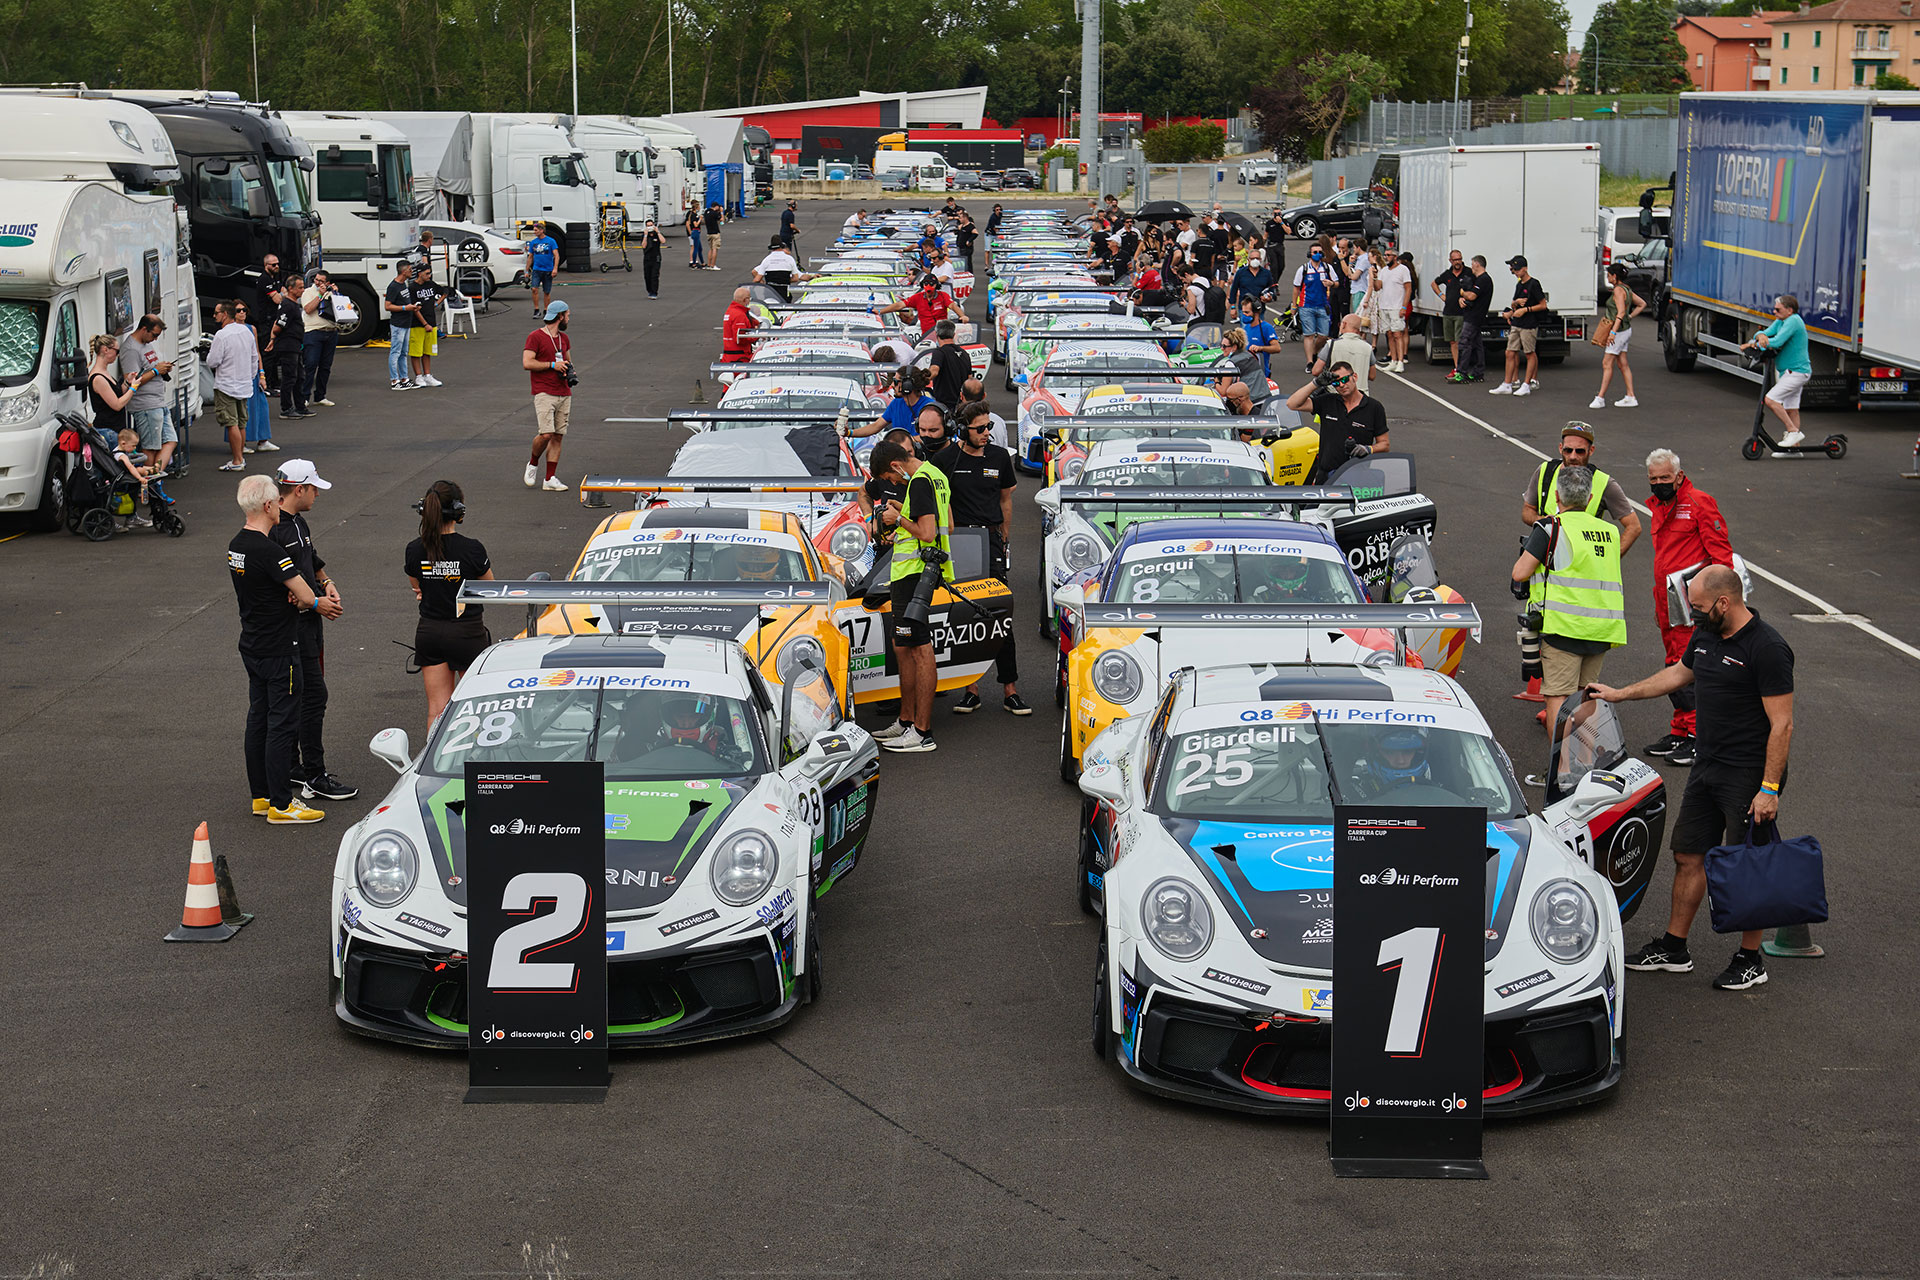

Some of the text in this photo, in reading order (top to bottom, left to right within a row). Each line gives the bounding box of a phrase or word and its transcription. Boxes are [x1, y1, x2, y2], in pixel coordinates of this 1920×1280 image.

[1807, 115, 1825, 147] HD
[1715, 152, 1770, 200] L'OPERA
[797, 388, 838, 396] Perform
[723, 396, 781, 409] Quaresmini
[1157, 396, 1200, 404] Perform
[1084, 403, 1133, 417] Moretti
[1119, 455, 1230, 465] Q8 Hi Perform
[1092, 463, 1157, 481] Iaquinta
[1149, 491, 1266, 499] discoverglo.it
[1357, 496, 1417, 513] Centro Porsche
[632, 532, 768, 545] Q8 Hi Perform
[1581, 530, 1613, 544] MEDIA
[583, 543, 664, 566] Fulgenzi
[1161, 543, 1302, 555] Q8 Hi Perform
[1594, 544, 1605, 558] 99
[432, 568, 461, 576] FULGENZI
[575, 559, 622, 582] 17
[1129, 557, 1195, 578] Cerqui
[477, 584, 816, 599] glo discoverglo.it glo
[955, 583, 986, 594] Centro
[1131, 577, 1160, 603] 8
[700, 605, 733, 613] Pesaro
[1103, 606, 1463, 622] glo discoverglo.it glo
[632, 623, 733, 633] SPAZIO ASTE
[842, 616, 872, 648] 17
[506, 674, 691, 689] Q8 Hi Perform
[859, 671, 883, 682] Perform
[456, 693, 537, 719] Amati
[1239, 708, 1437, 724] Q8 Hi Perform
[441, 710, 518, 755] 28
[1182, 727, 1297, 754] Giardelli
[1174, 746, 1255, 797] 25
[617, 788, 680, 798] Firenze
[798, 786, 821, 826] 28
[489, 823, 581, 836] Q8 Hi Perform
[1347, 819, 1418, 827] PORSCHE
[1243, 829, 1306, 840] Centro
[1347, 829, 1374, 837] CARRERA
[1614, 845, 1642, 871] NAUSIKA
[1359, 874, 1460, 888] Q8 Hi Perform
[487, 872, 588, 989] 2
[1376, 926, 1441, 1053] 1
[481, 1023, 595, 1044] glo discoverglo.it glo
[1344, 1090, 1468, 1113] glo discoverglo.it glo
